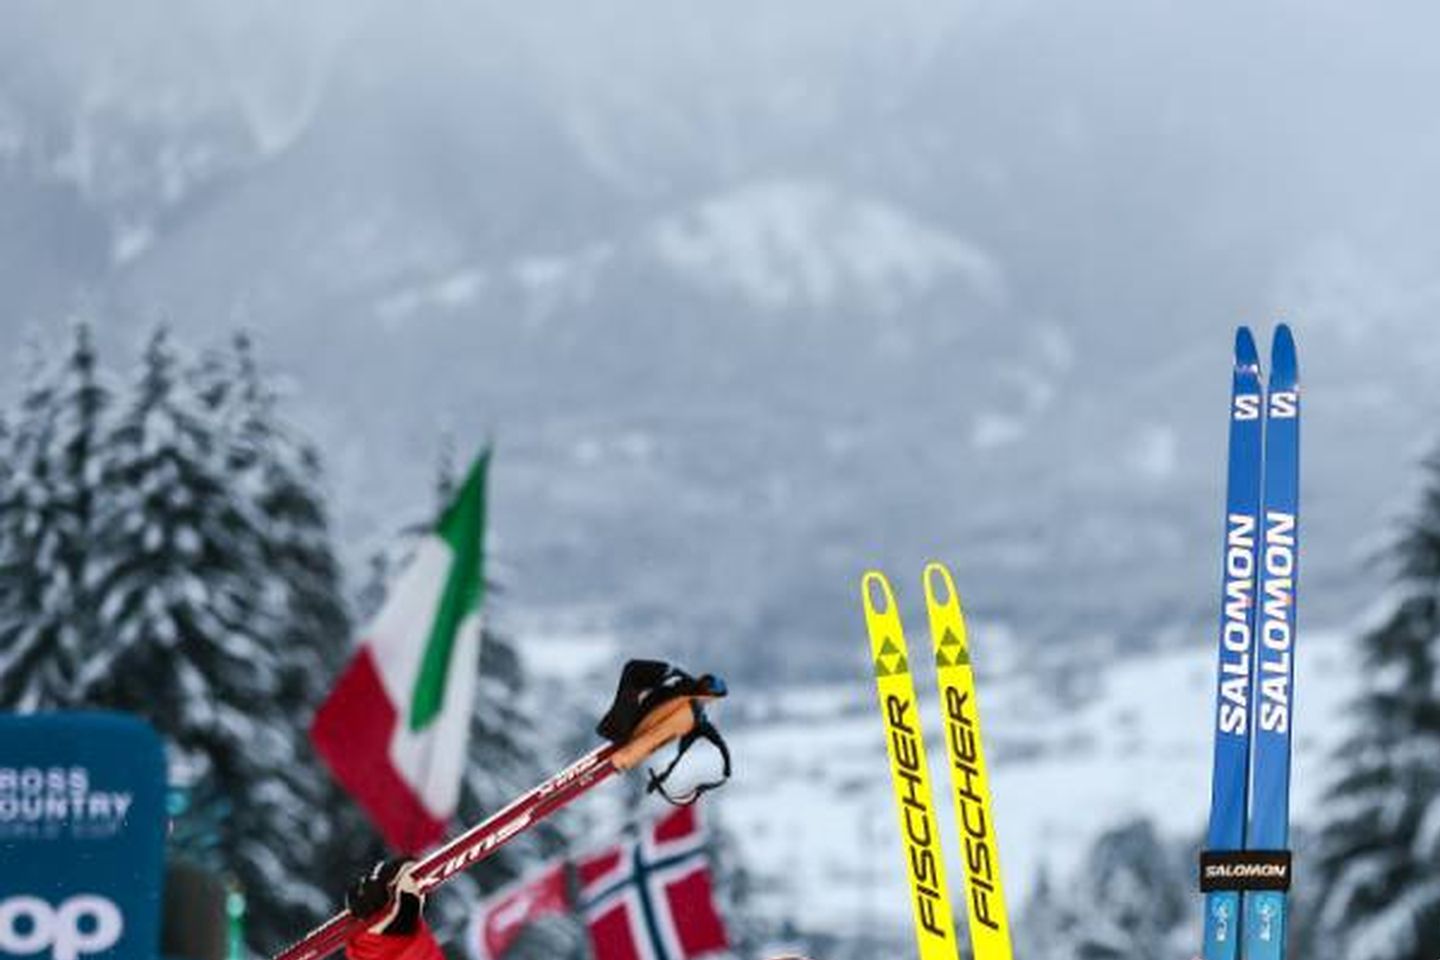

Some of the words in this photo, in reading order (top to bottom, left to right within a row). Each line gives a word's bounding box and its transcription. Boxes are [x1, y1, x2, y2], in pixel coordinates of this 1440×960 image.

[1220, 513, 1255, 735] SALOMON
[1261, 511, 1295, 733] SALOMON
[887, 693, 946, 938] FISCHER
[945, 686, 999, 931] FISCHER
[1205, 863, 1287, 879] SALOMON
